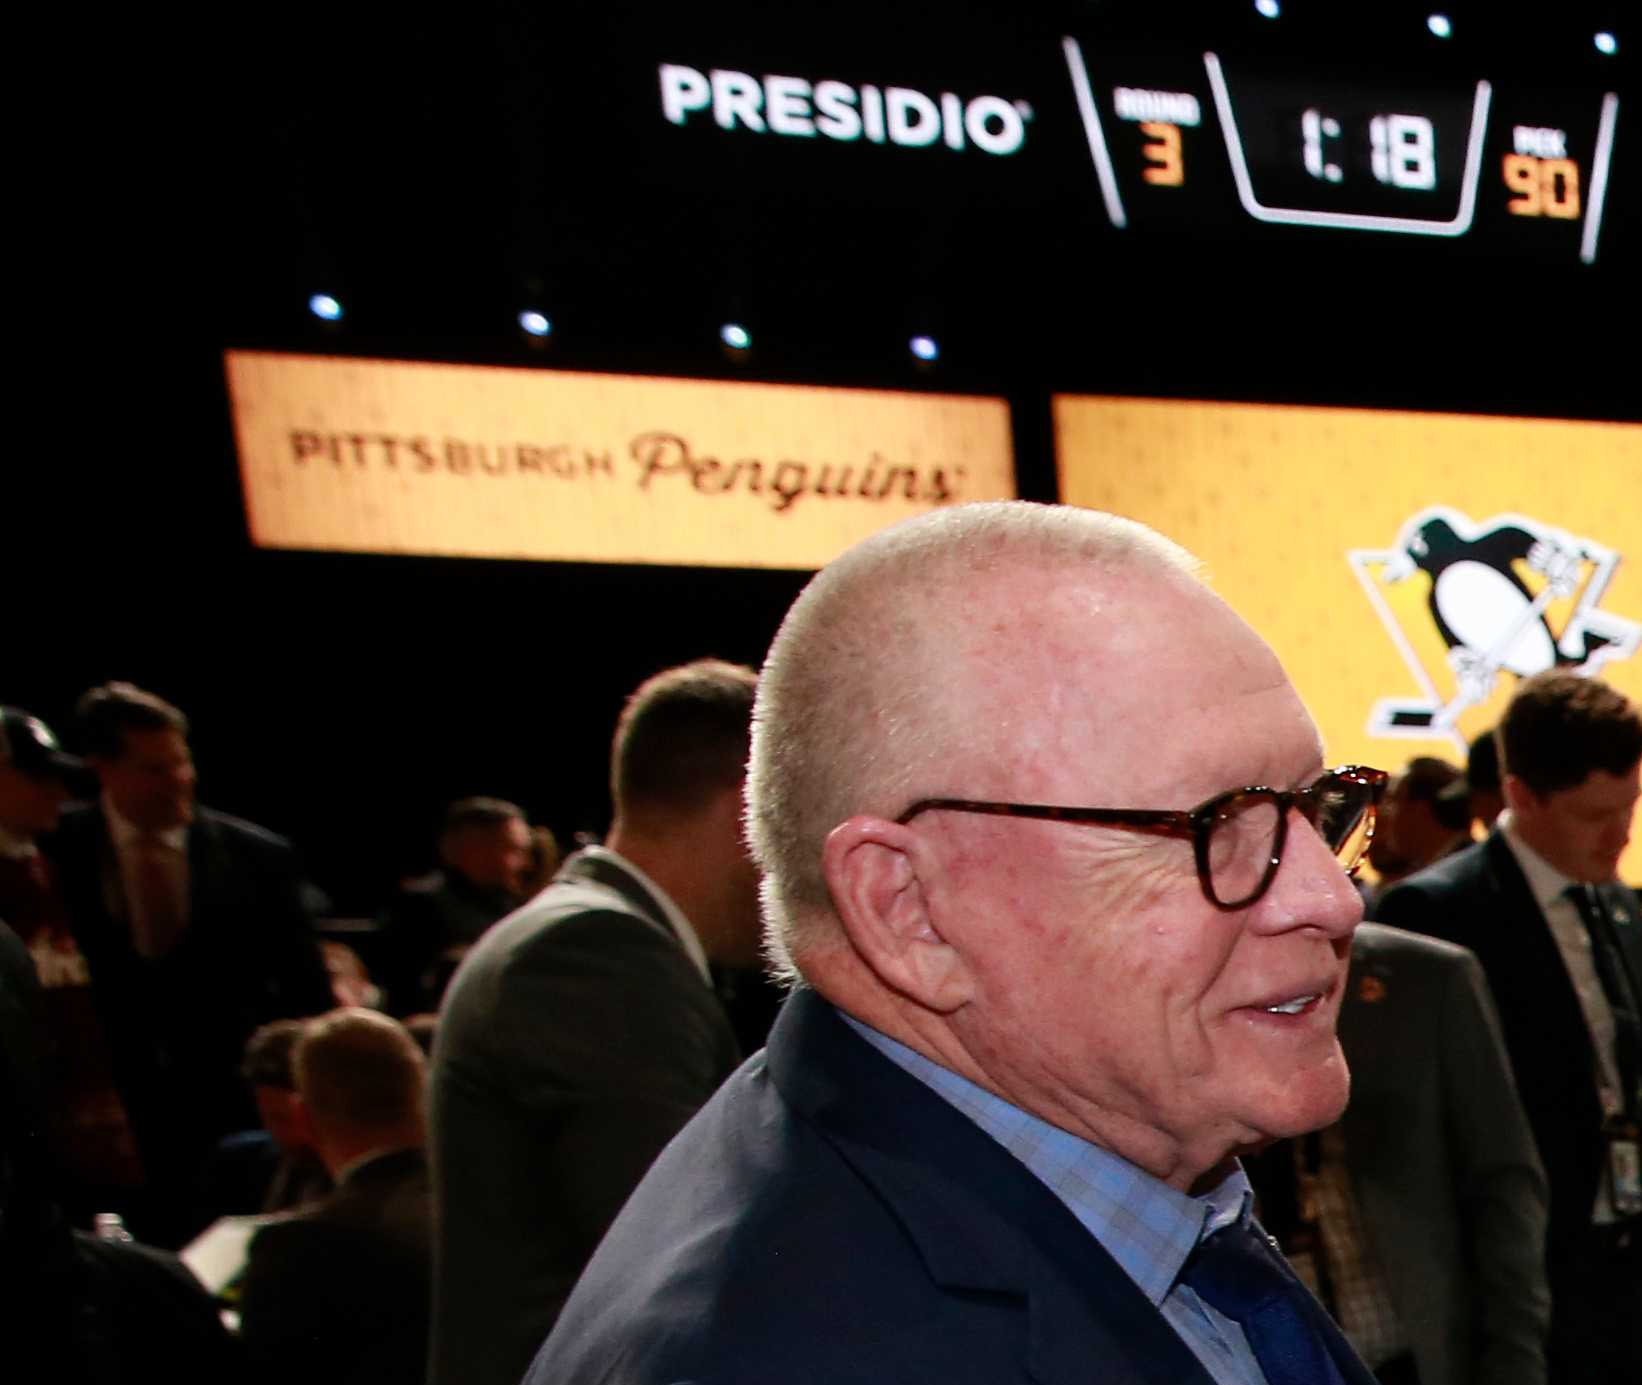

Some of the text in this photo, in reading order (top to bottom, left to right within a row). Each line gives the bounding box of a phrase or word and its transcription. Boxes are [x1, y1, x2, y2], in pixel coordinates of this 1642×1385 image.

[660, 64, 1033, 154] PRESIDIO
[1303, 108, 1437, 190] 1:18
[1140, 122, 1184, 186] 3
[1503, 154, 1579, 219] 90
[288, 430, 963, 511] PITTSBURGH Penguins
